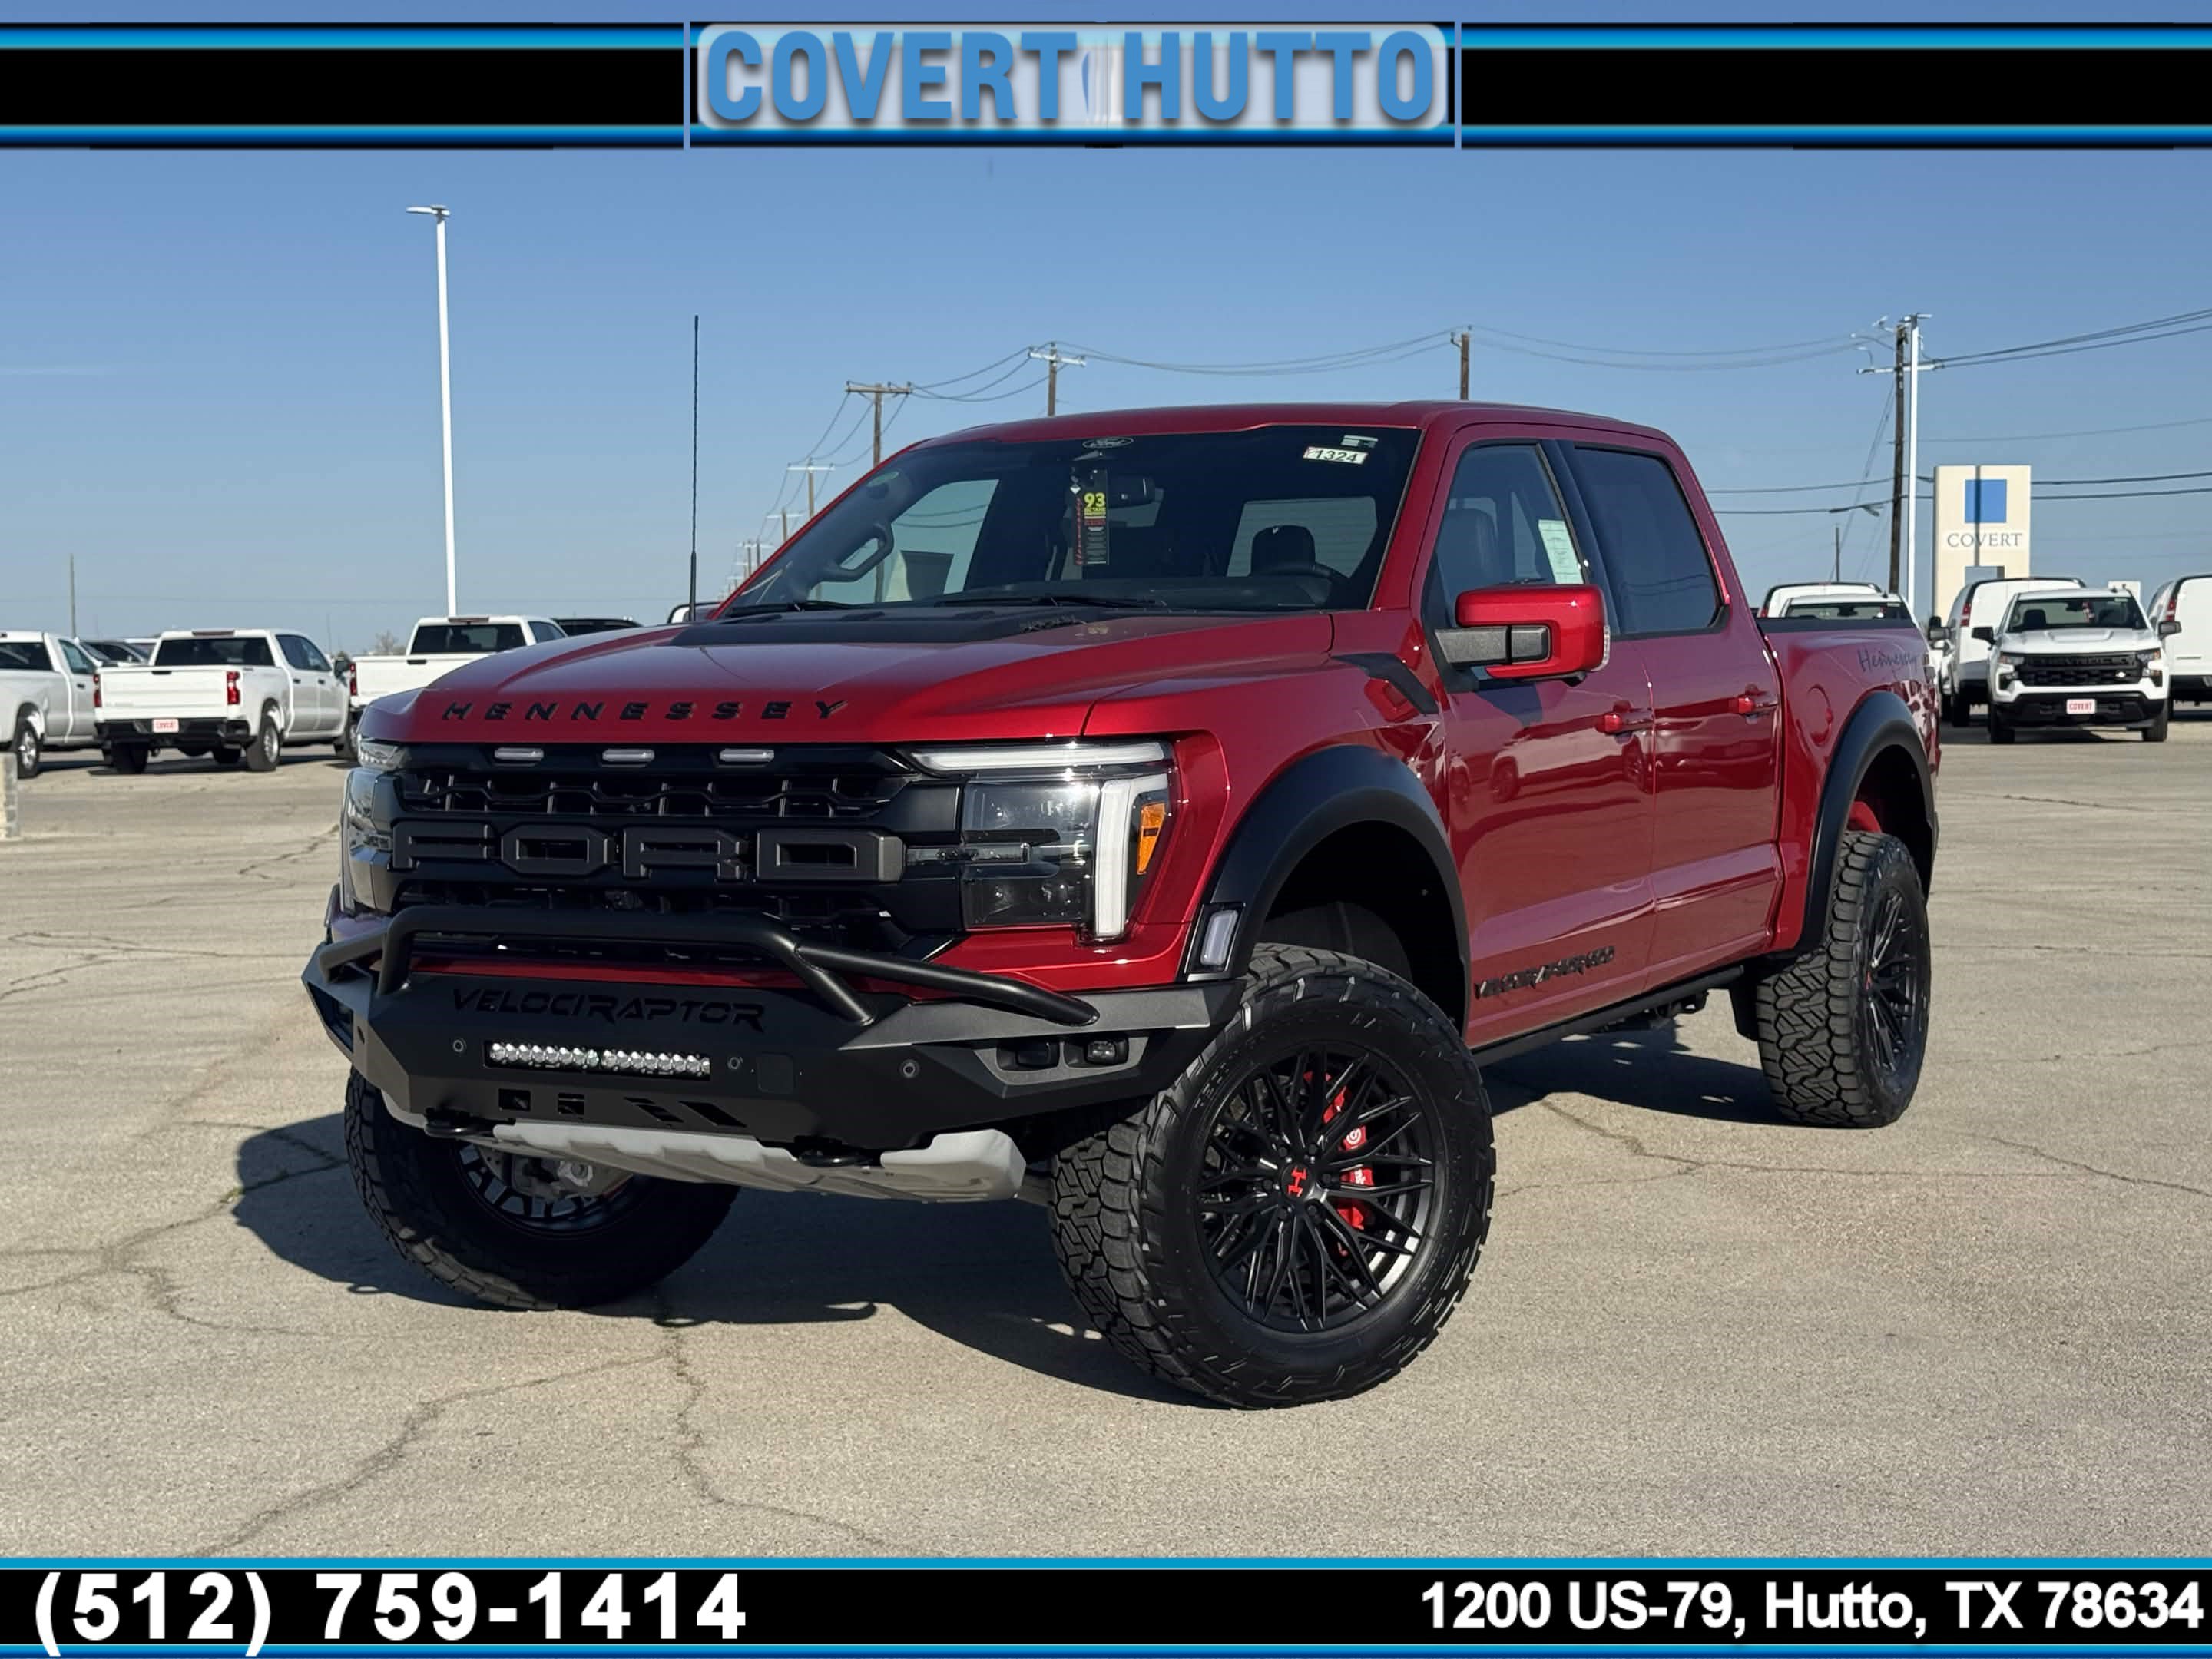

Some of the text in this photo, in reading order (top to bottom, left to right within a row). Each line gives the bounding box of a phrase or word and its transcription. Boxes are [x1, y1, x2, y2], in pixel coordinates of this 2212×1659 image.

[1315, 449, 1358, 462] 1324
[1084, 492, 1106, 508] 93
[1947, 533, 2022, 547] COVERT
[442, 700, 848, 720] HENNESSEY
[387, 822, 905, 882] FORD
[453, 988, 765, 1033] VELOCIRAPTOR
